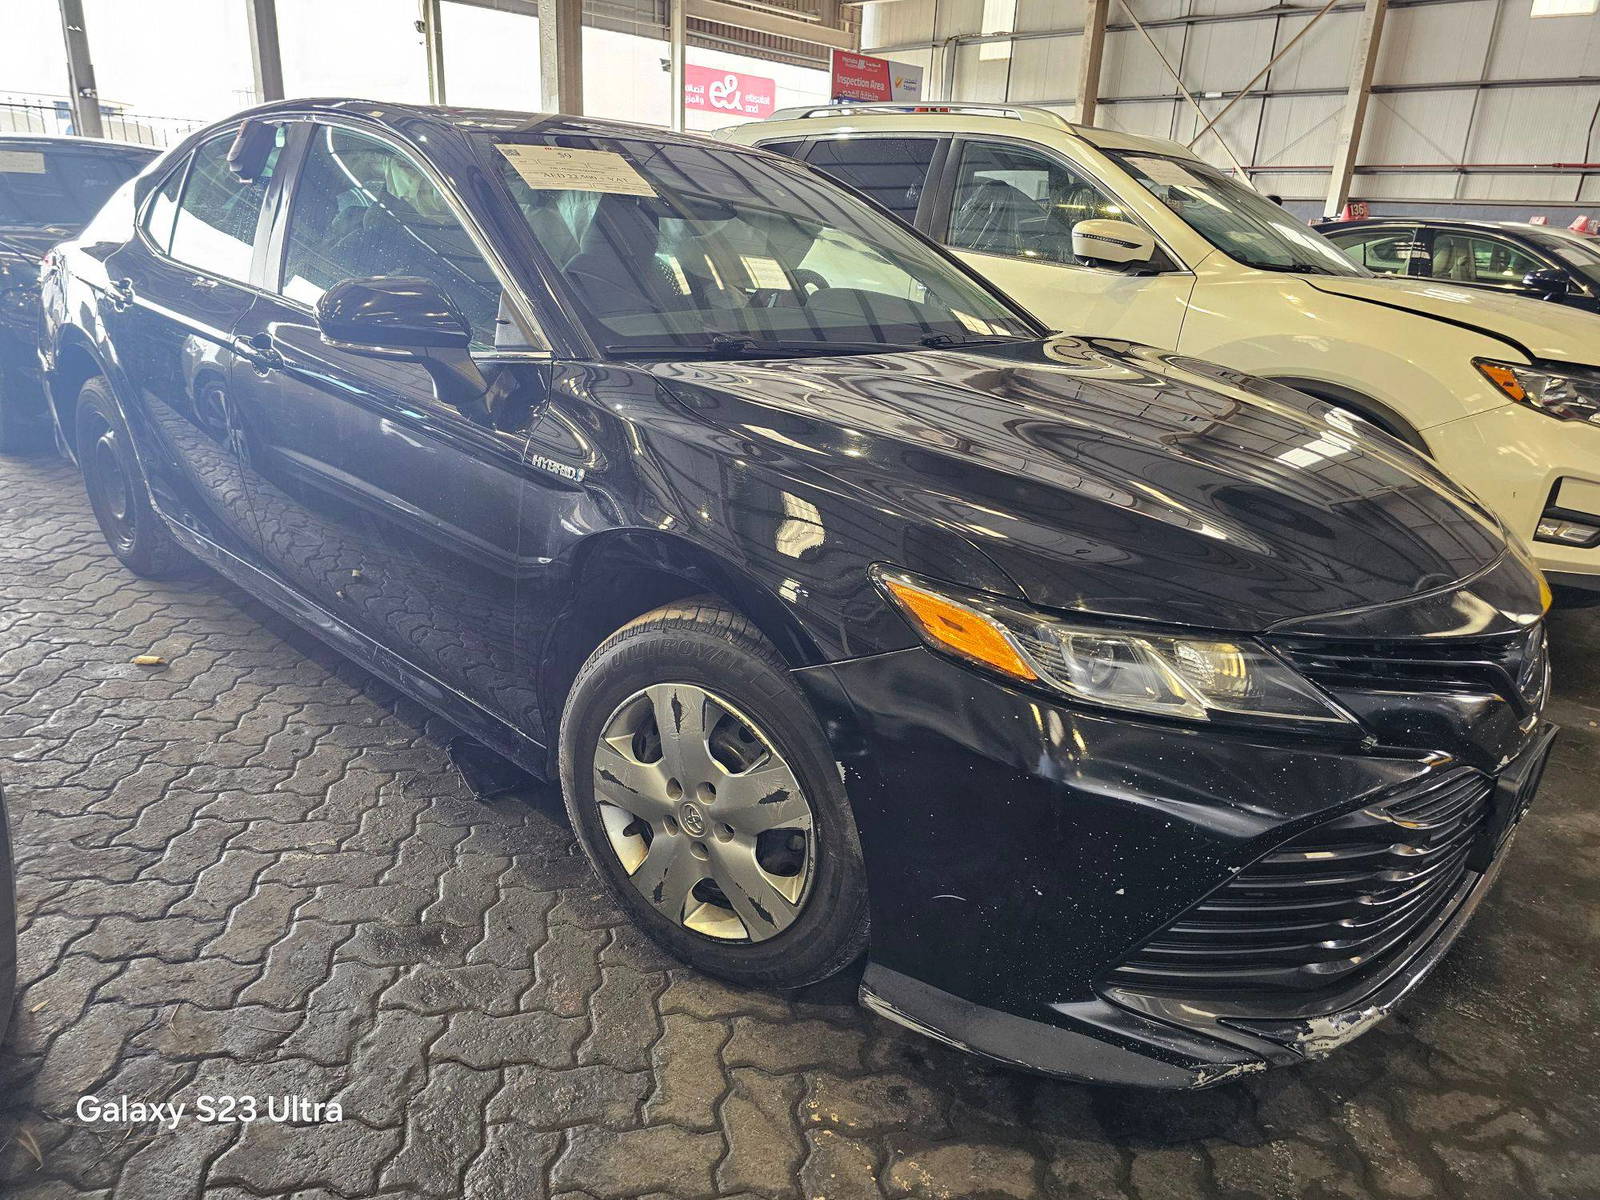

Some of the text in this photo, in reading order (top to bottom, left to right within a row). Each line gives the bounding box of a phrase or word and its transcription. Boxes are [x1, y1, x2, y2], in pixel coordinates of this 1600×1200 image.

[837, 73, 885, 91] Inspection Area
[531, 454, 576, 480] HYBRID
